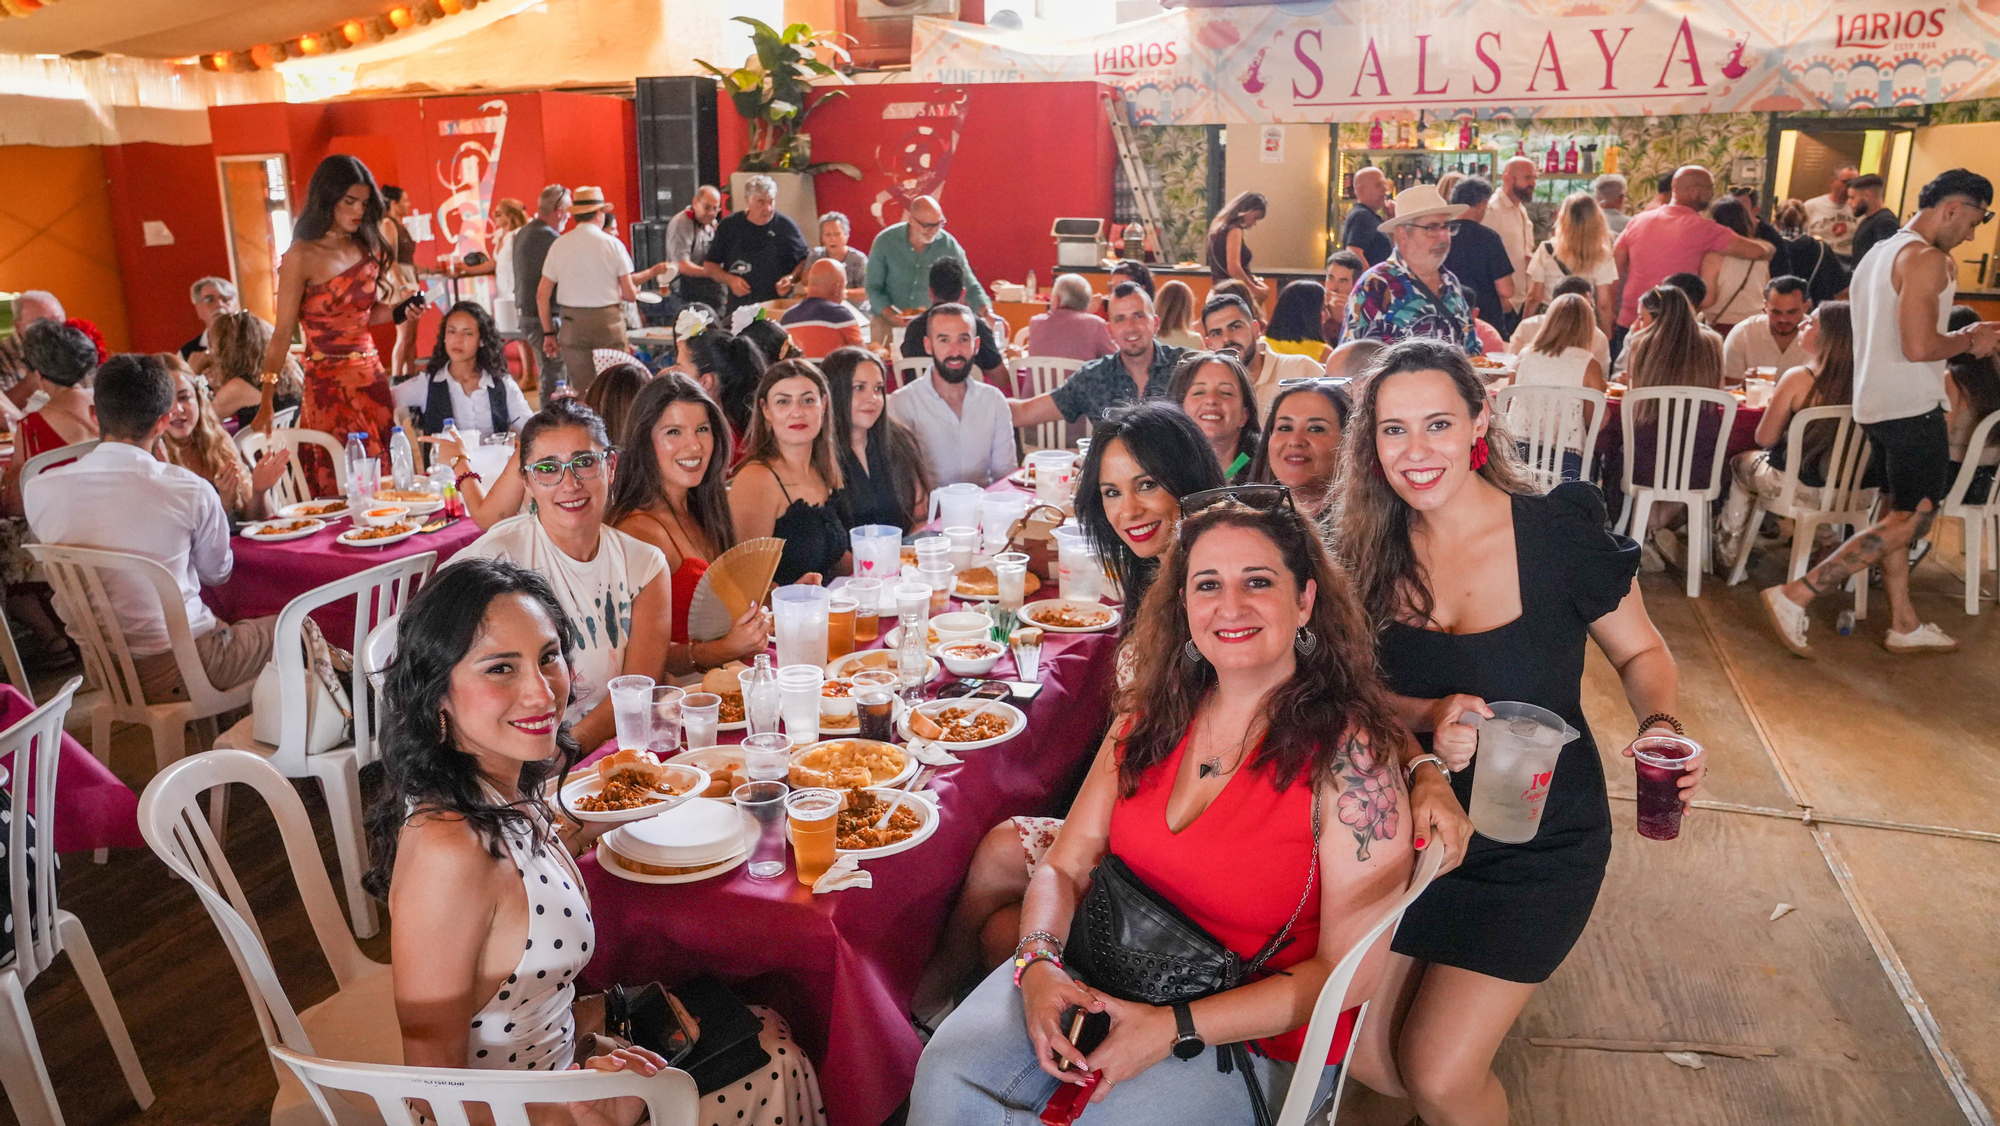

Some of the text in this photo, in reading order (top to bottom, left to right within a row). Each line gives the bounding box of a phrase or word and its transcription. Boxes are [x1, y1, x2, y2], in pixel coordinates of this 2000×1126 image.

[1836, 8, 1946, 49] LARIOS
[1095, 41, 1177, 76] LARIOS
[1291, 15, 1708, 100] SALSAYA
